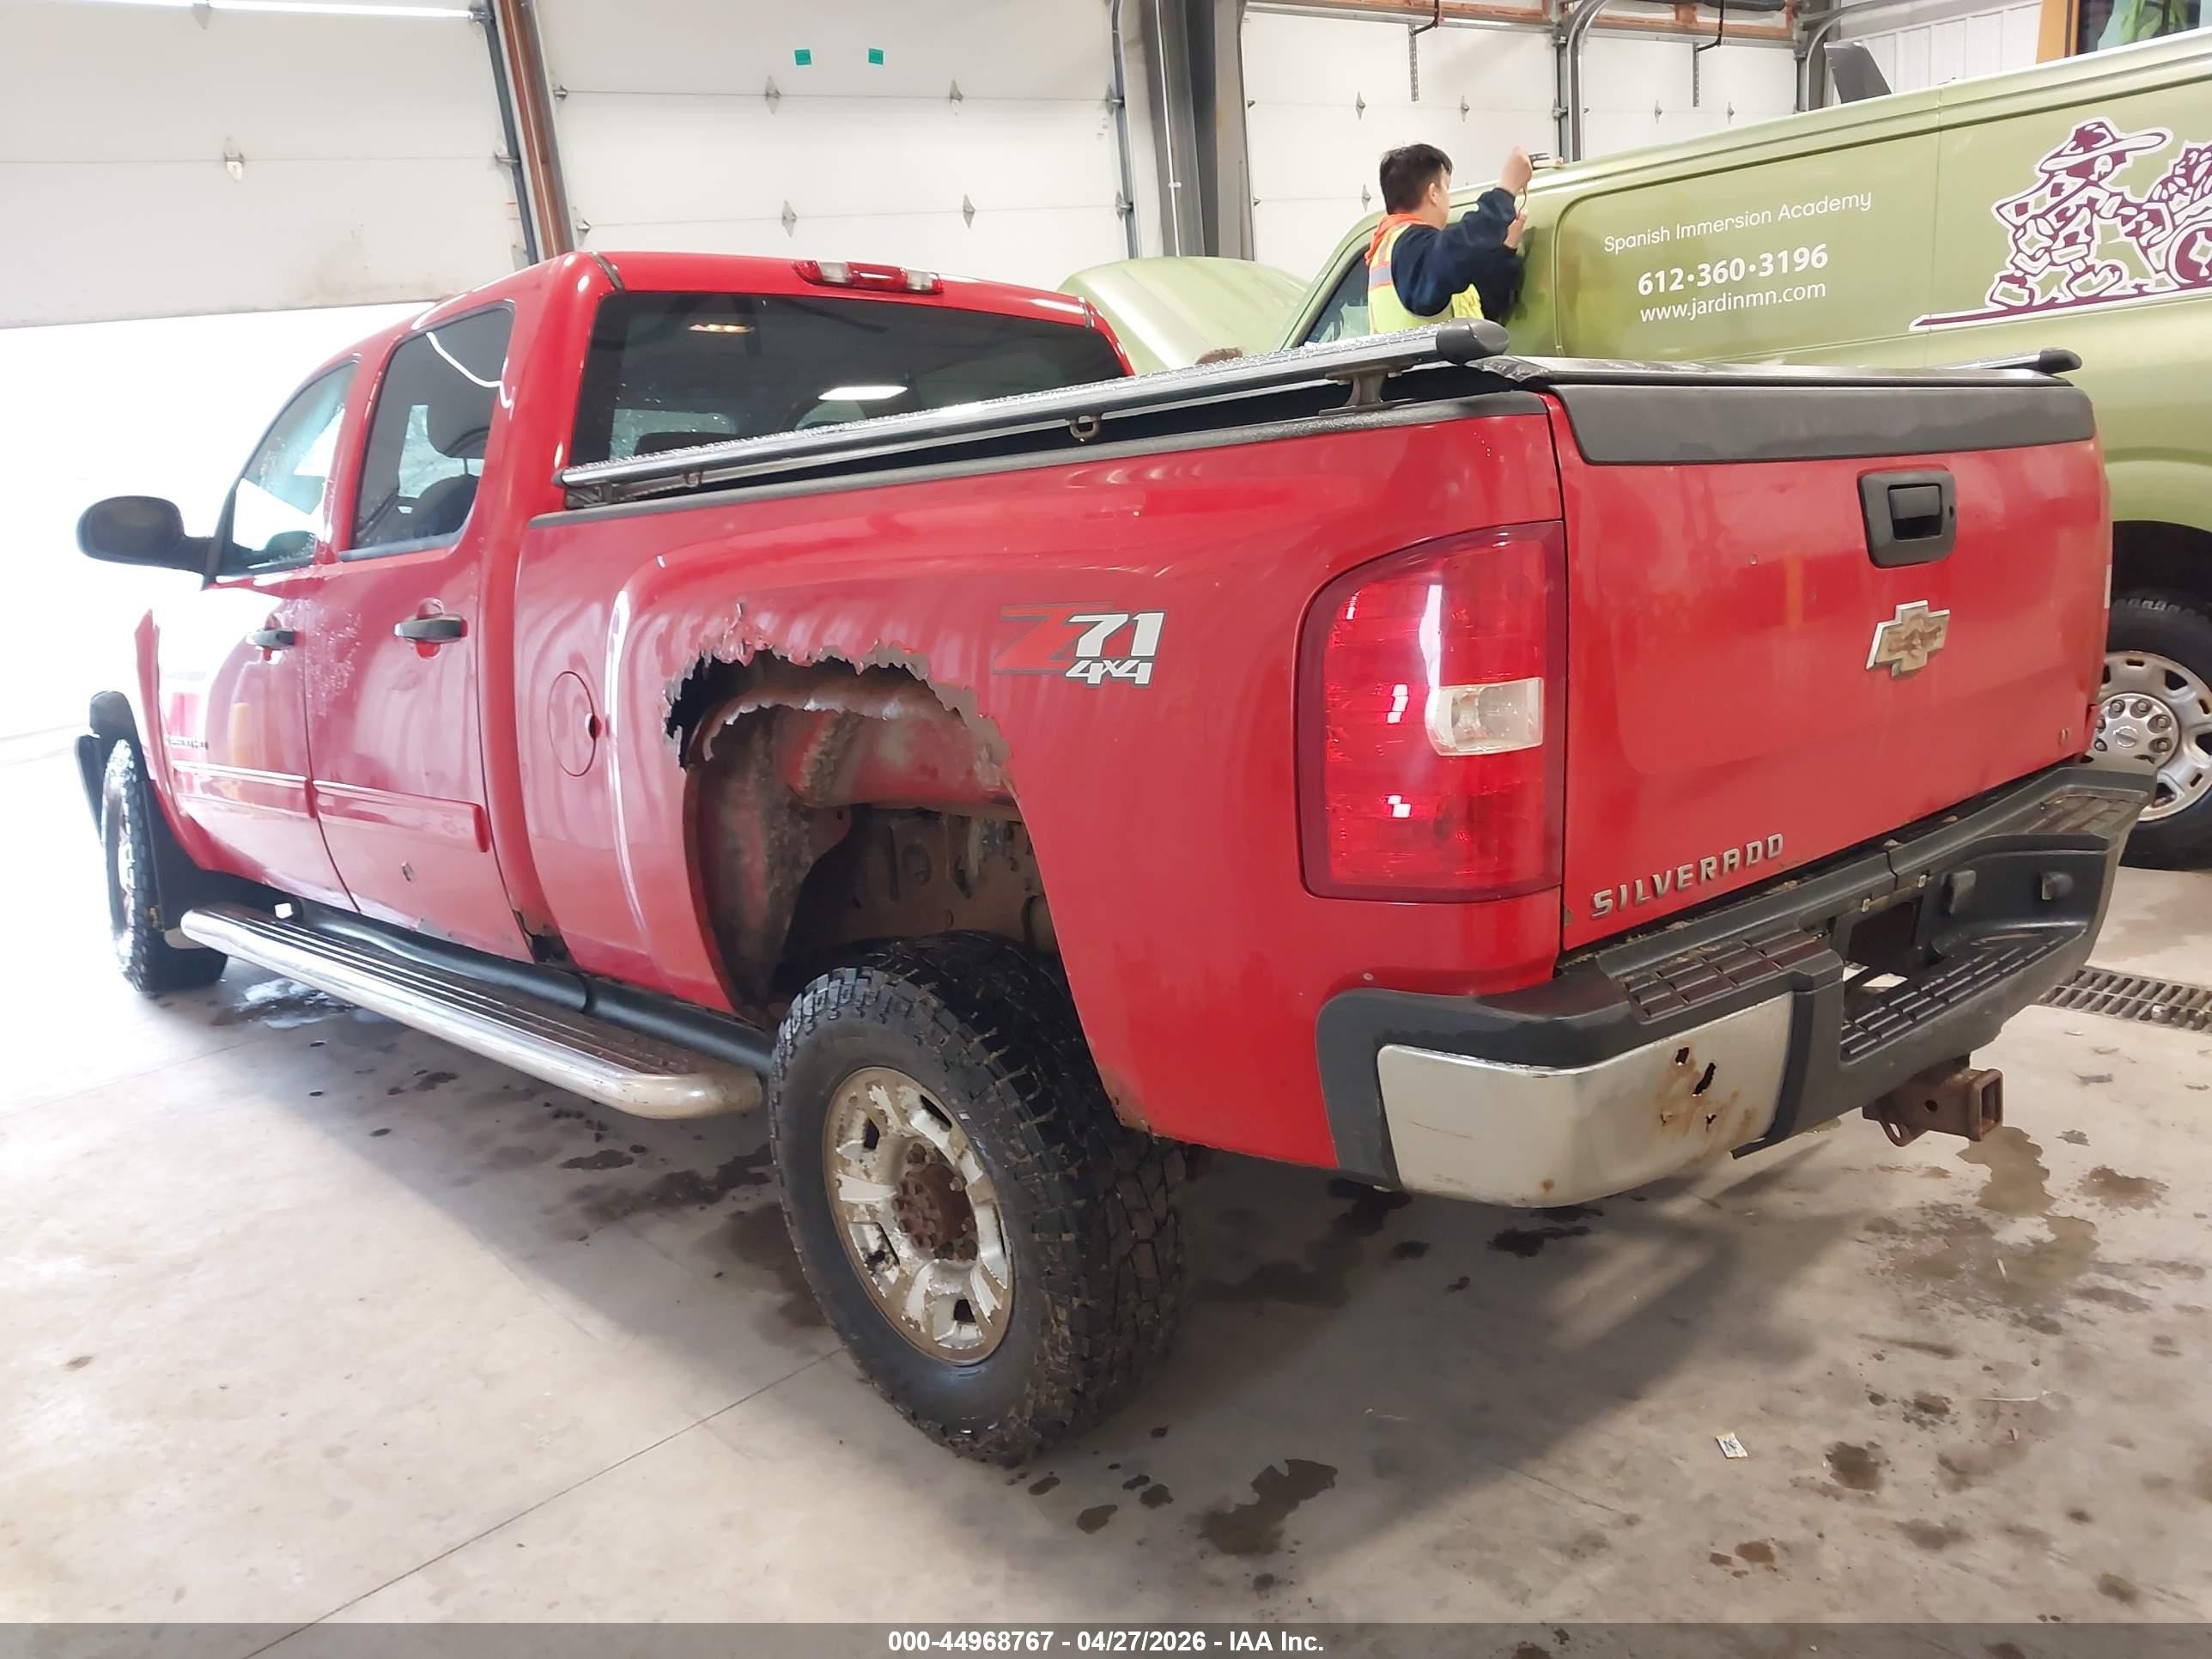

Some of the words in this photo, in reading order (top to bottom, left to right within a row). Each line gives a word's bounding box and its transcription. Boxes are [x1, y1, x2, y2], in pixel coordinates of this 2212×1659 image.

[1604, 226, 1670, 255] Spanish
[1676, 209, 1771, 240] Immersion
[1778, 191, 1872, 222] Academy
[1640, 282, 1826, 323] www.jardinmn.com
[993, 601, 1167, 673] Z71
[1590, 832, 1784, 918] SILVERADO
